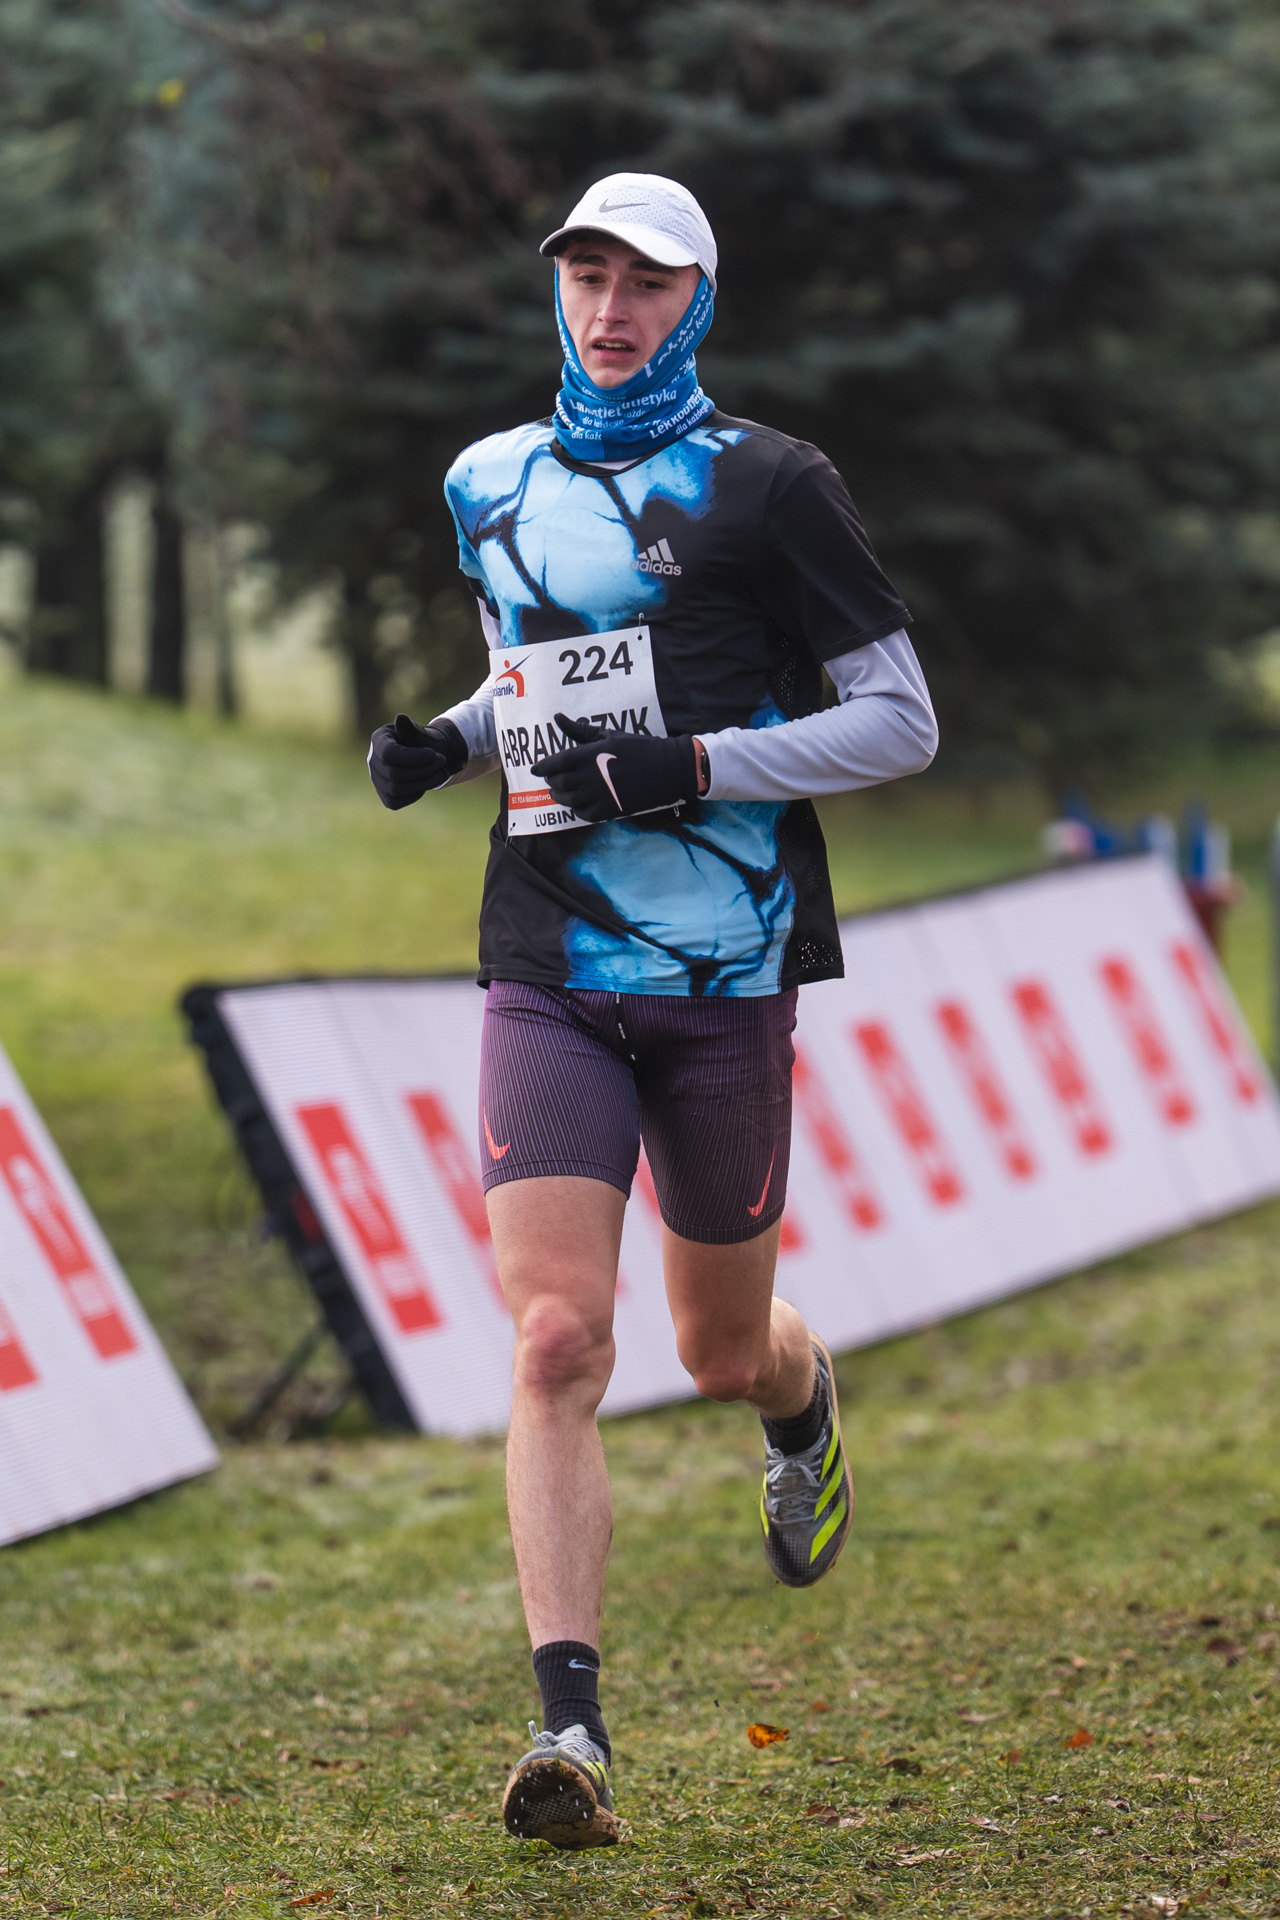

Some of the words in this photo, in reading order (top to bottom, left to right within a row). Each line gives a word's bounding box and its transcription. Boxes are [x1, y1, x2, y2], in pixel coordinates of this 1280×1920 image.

[629, 559, 682, 576] adidas
[559, 641, 633, 686] 224
[534, 810, 576, 827] LUBIN
